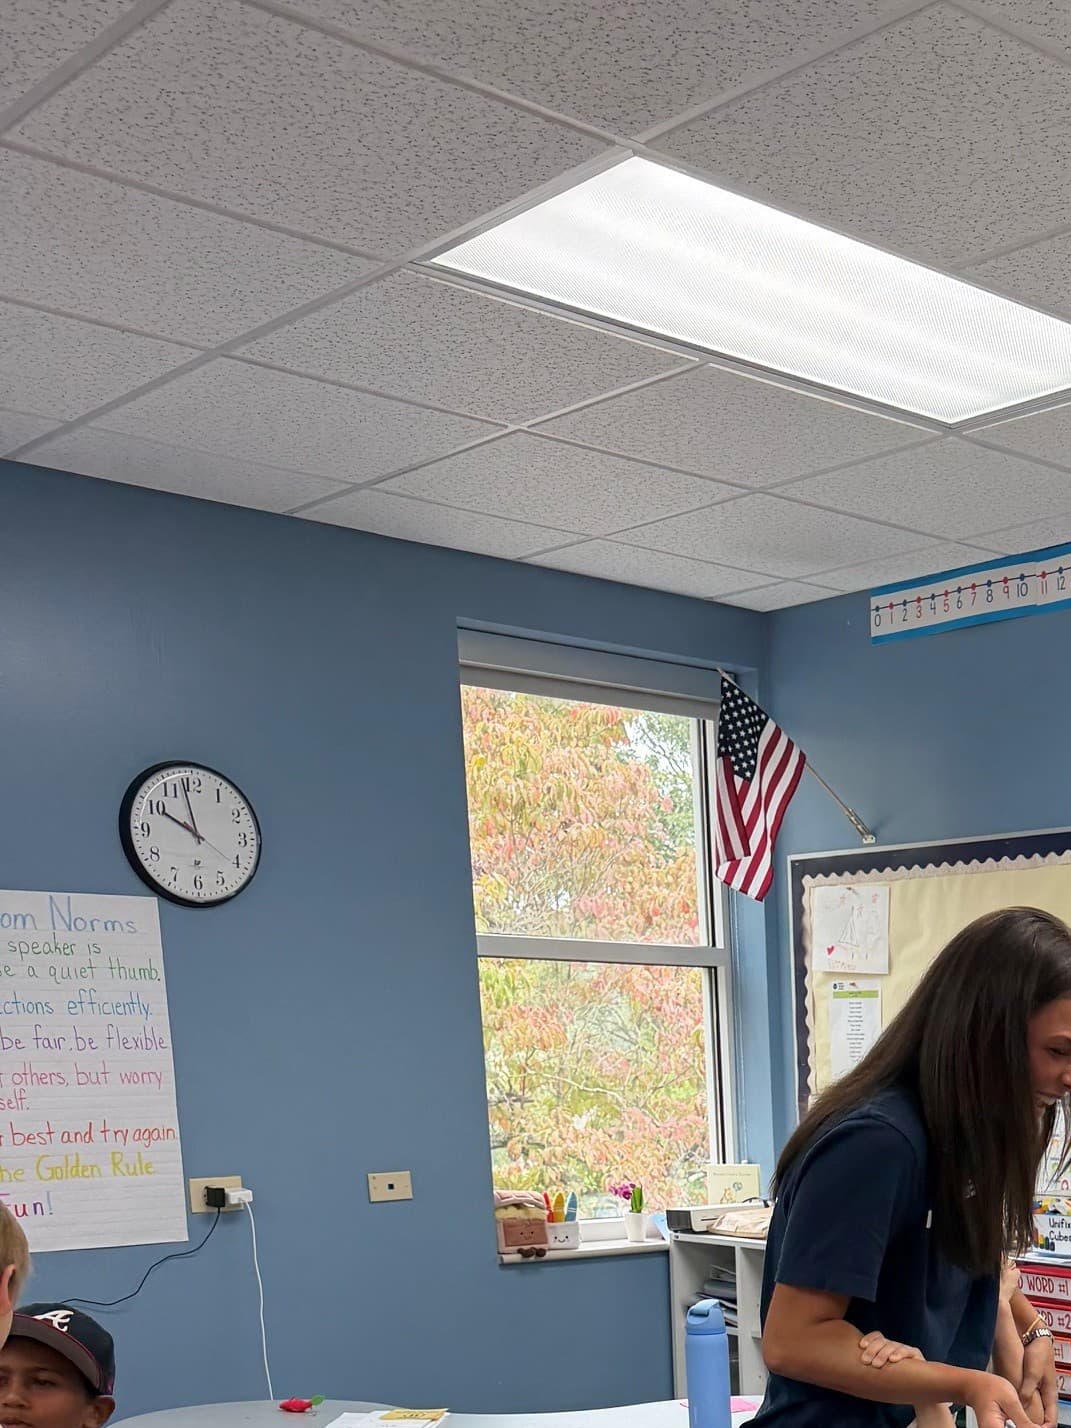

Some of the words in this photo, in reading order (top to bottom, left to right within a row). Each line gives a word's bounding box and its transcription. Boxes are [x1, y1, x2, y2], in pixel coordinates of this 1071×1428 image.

[163, 782, 178, 798] 11
[184, 777, 202, 793] 12
[216, 788, 220, 803] 1
[150, 800, 166, 816] 10
[232, 808, 240, 824] 2
[141, 822, 150, 838] 9
[238, 832, 248, 848] 3
[150, 846, 160, 862] 8
[232, 854, 241, 868] 4
[170, 866, 179, 882] 7
[194, 874, 202, 890] 6
[216, 871, 224, 886] 5
[49, 895, 138, 934] Norms
[8, 932, 76, 960] speaker
[88, 943, 102, 954] is
[28, 965, 38, 978] a
[49, 958, 97, 985] quiet
[108, 956, 161, 982] thumb.
[0, 992, 54, 1014] ctions
[68, 988, 153, 1020] efficiently.
[74, 1026, 99, 1051] be
[106, 1024, 168, 1051] flexible
[74, 1060, 110, 1086] but
[120, 1071, 164, 1090] worry
[10, 1121, 56, 1146] best
[61, 1121, 94, 1144] and
[100, 1119, 129, 1148] try
[36, 1152, 102, 1182] Golden
[111, 1151, 157, 1178] Rule
[1049, 1217, 1071, 1230] Unifix
[1028, 1276, 1055, 1294] WORD
[33, 1309, 74, 1334] A
